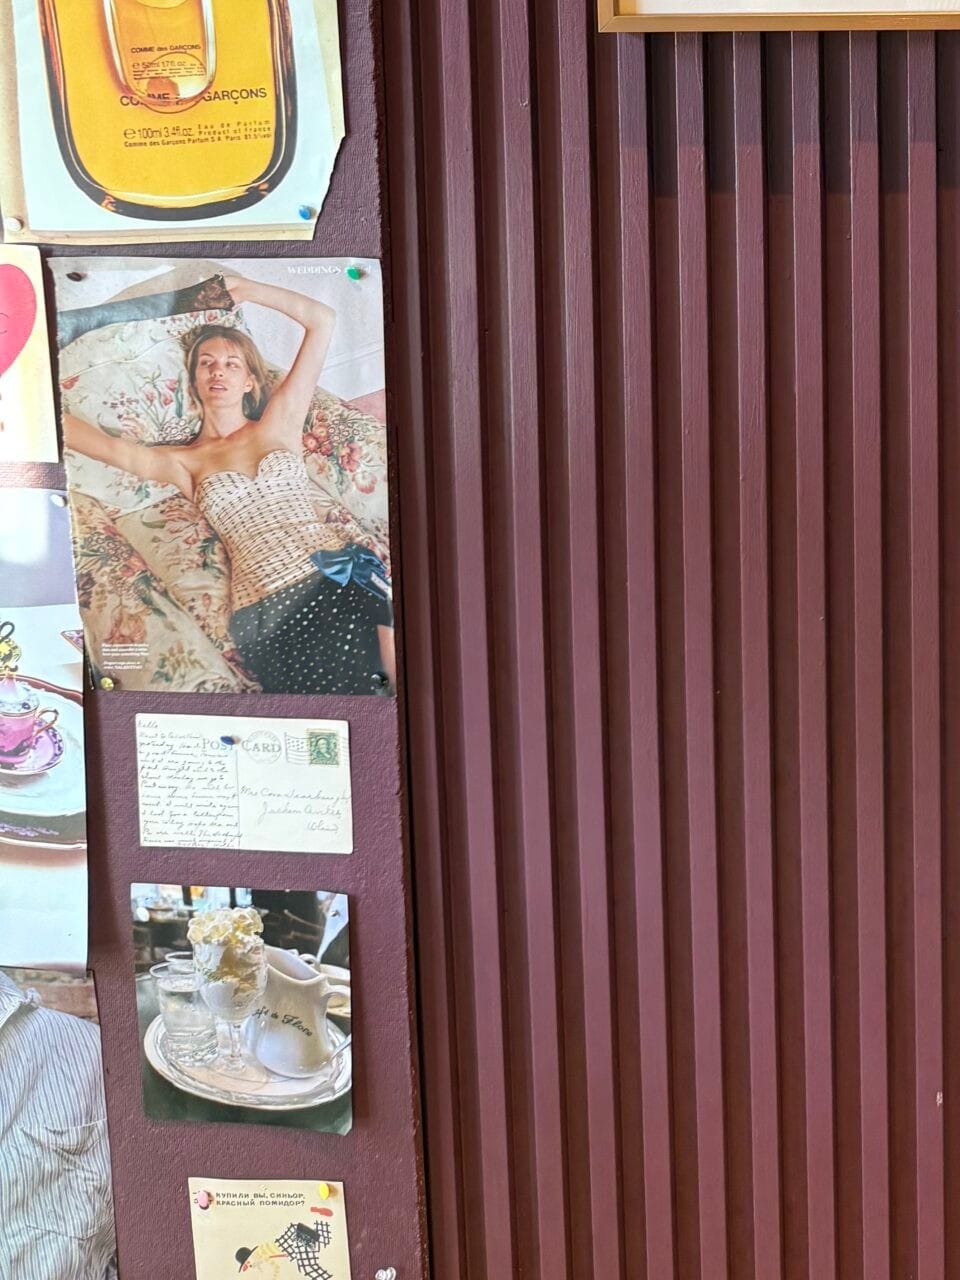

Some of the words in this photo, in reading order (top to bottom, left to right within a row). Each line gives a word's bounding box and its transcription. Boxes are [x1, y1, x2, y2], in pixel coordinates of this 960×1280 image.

[203, 87, 267, 105] GARÇONS
[241, 740, 281, 753] CARD
[281, 1014, 313, 1037] Flore
